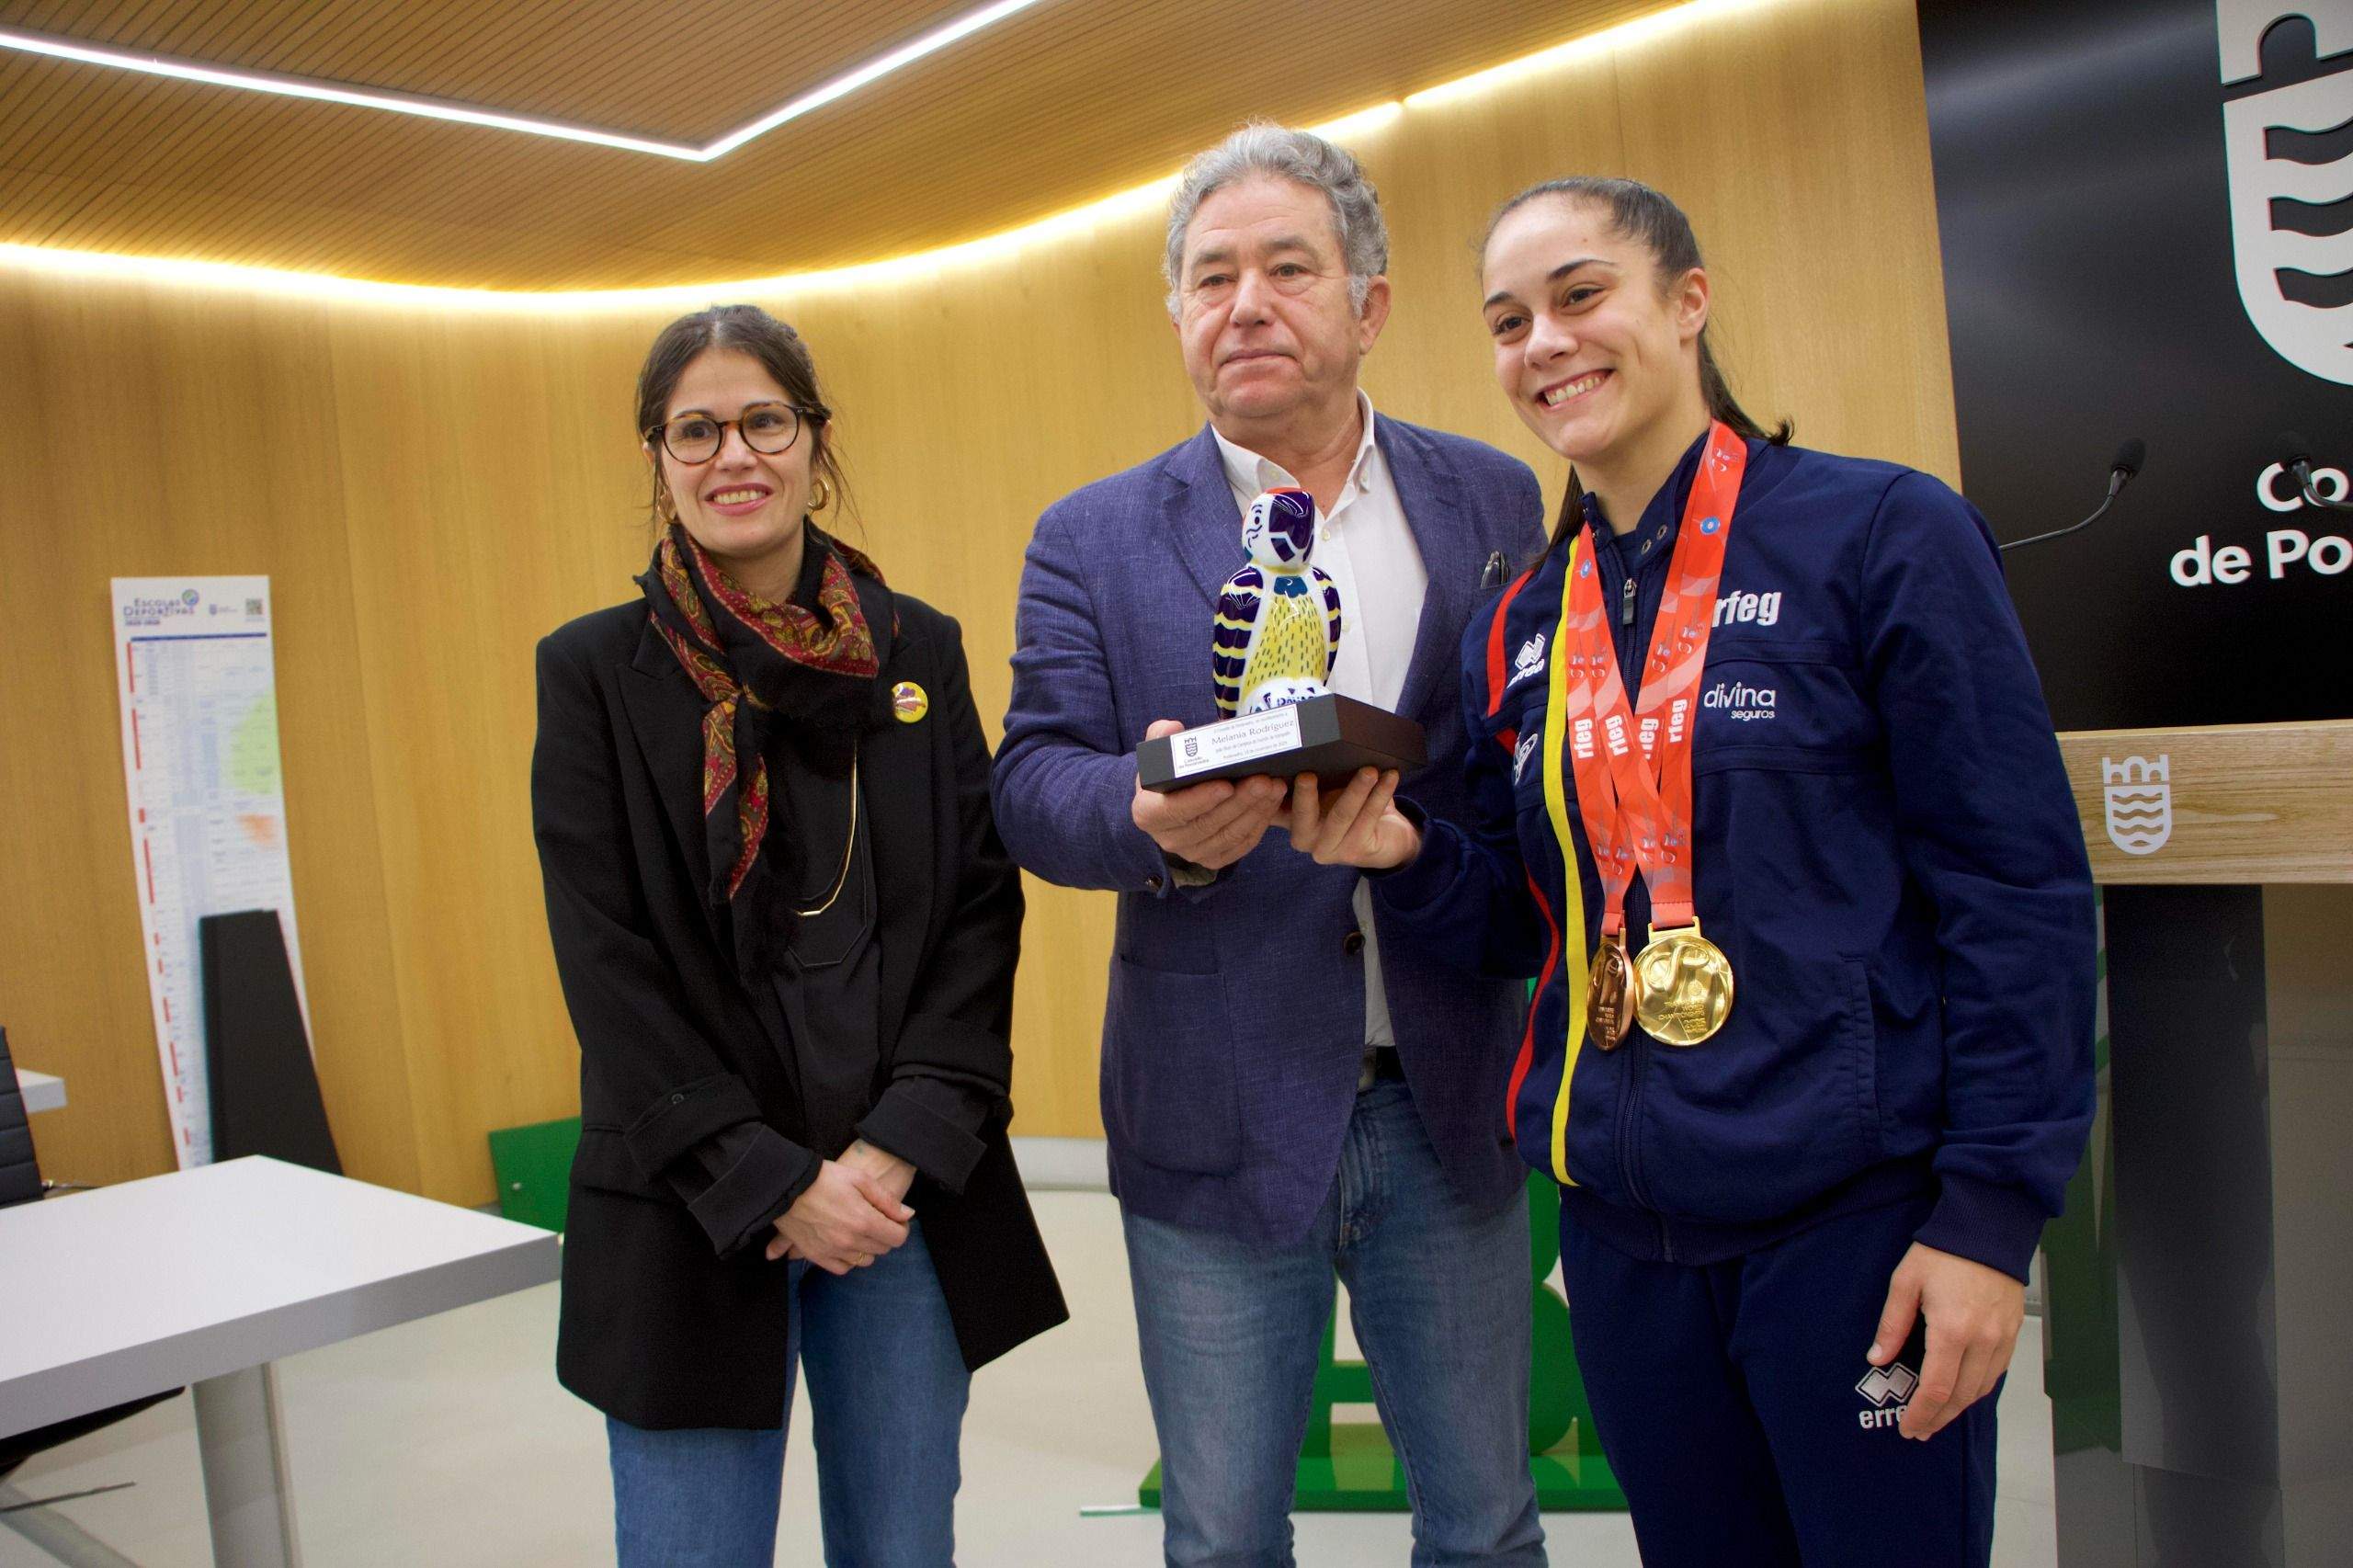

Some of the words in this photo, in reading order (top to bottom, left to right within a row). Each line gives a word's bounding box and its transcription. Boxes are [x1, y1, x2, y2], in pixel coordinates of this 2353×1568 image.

[2170, 535, 2252, 587] de
[2267, 528, 2353, 579] Po
[1711, 590, 1782, 628] rfeg
[1703, 681, 1776, 709] divina
[1605, 715, 1629, 756] rfeg
[1668, 699, 1688, 743] rfeg
[1730, 710, 1776, 722] seguros
[1574, 718, 1594, 759] rfeg
